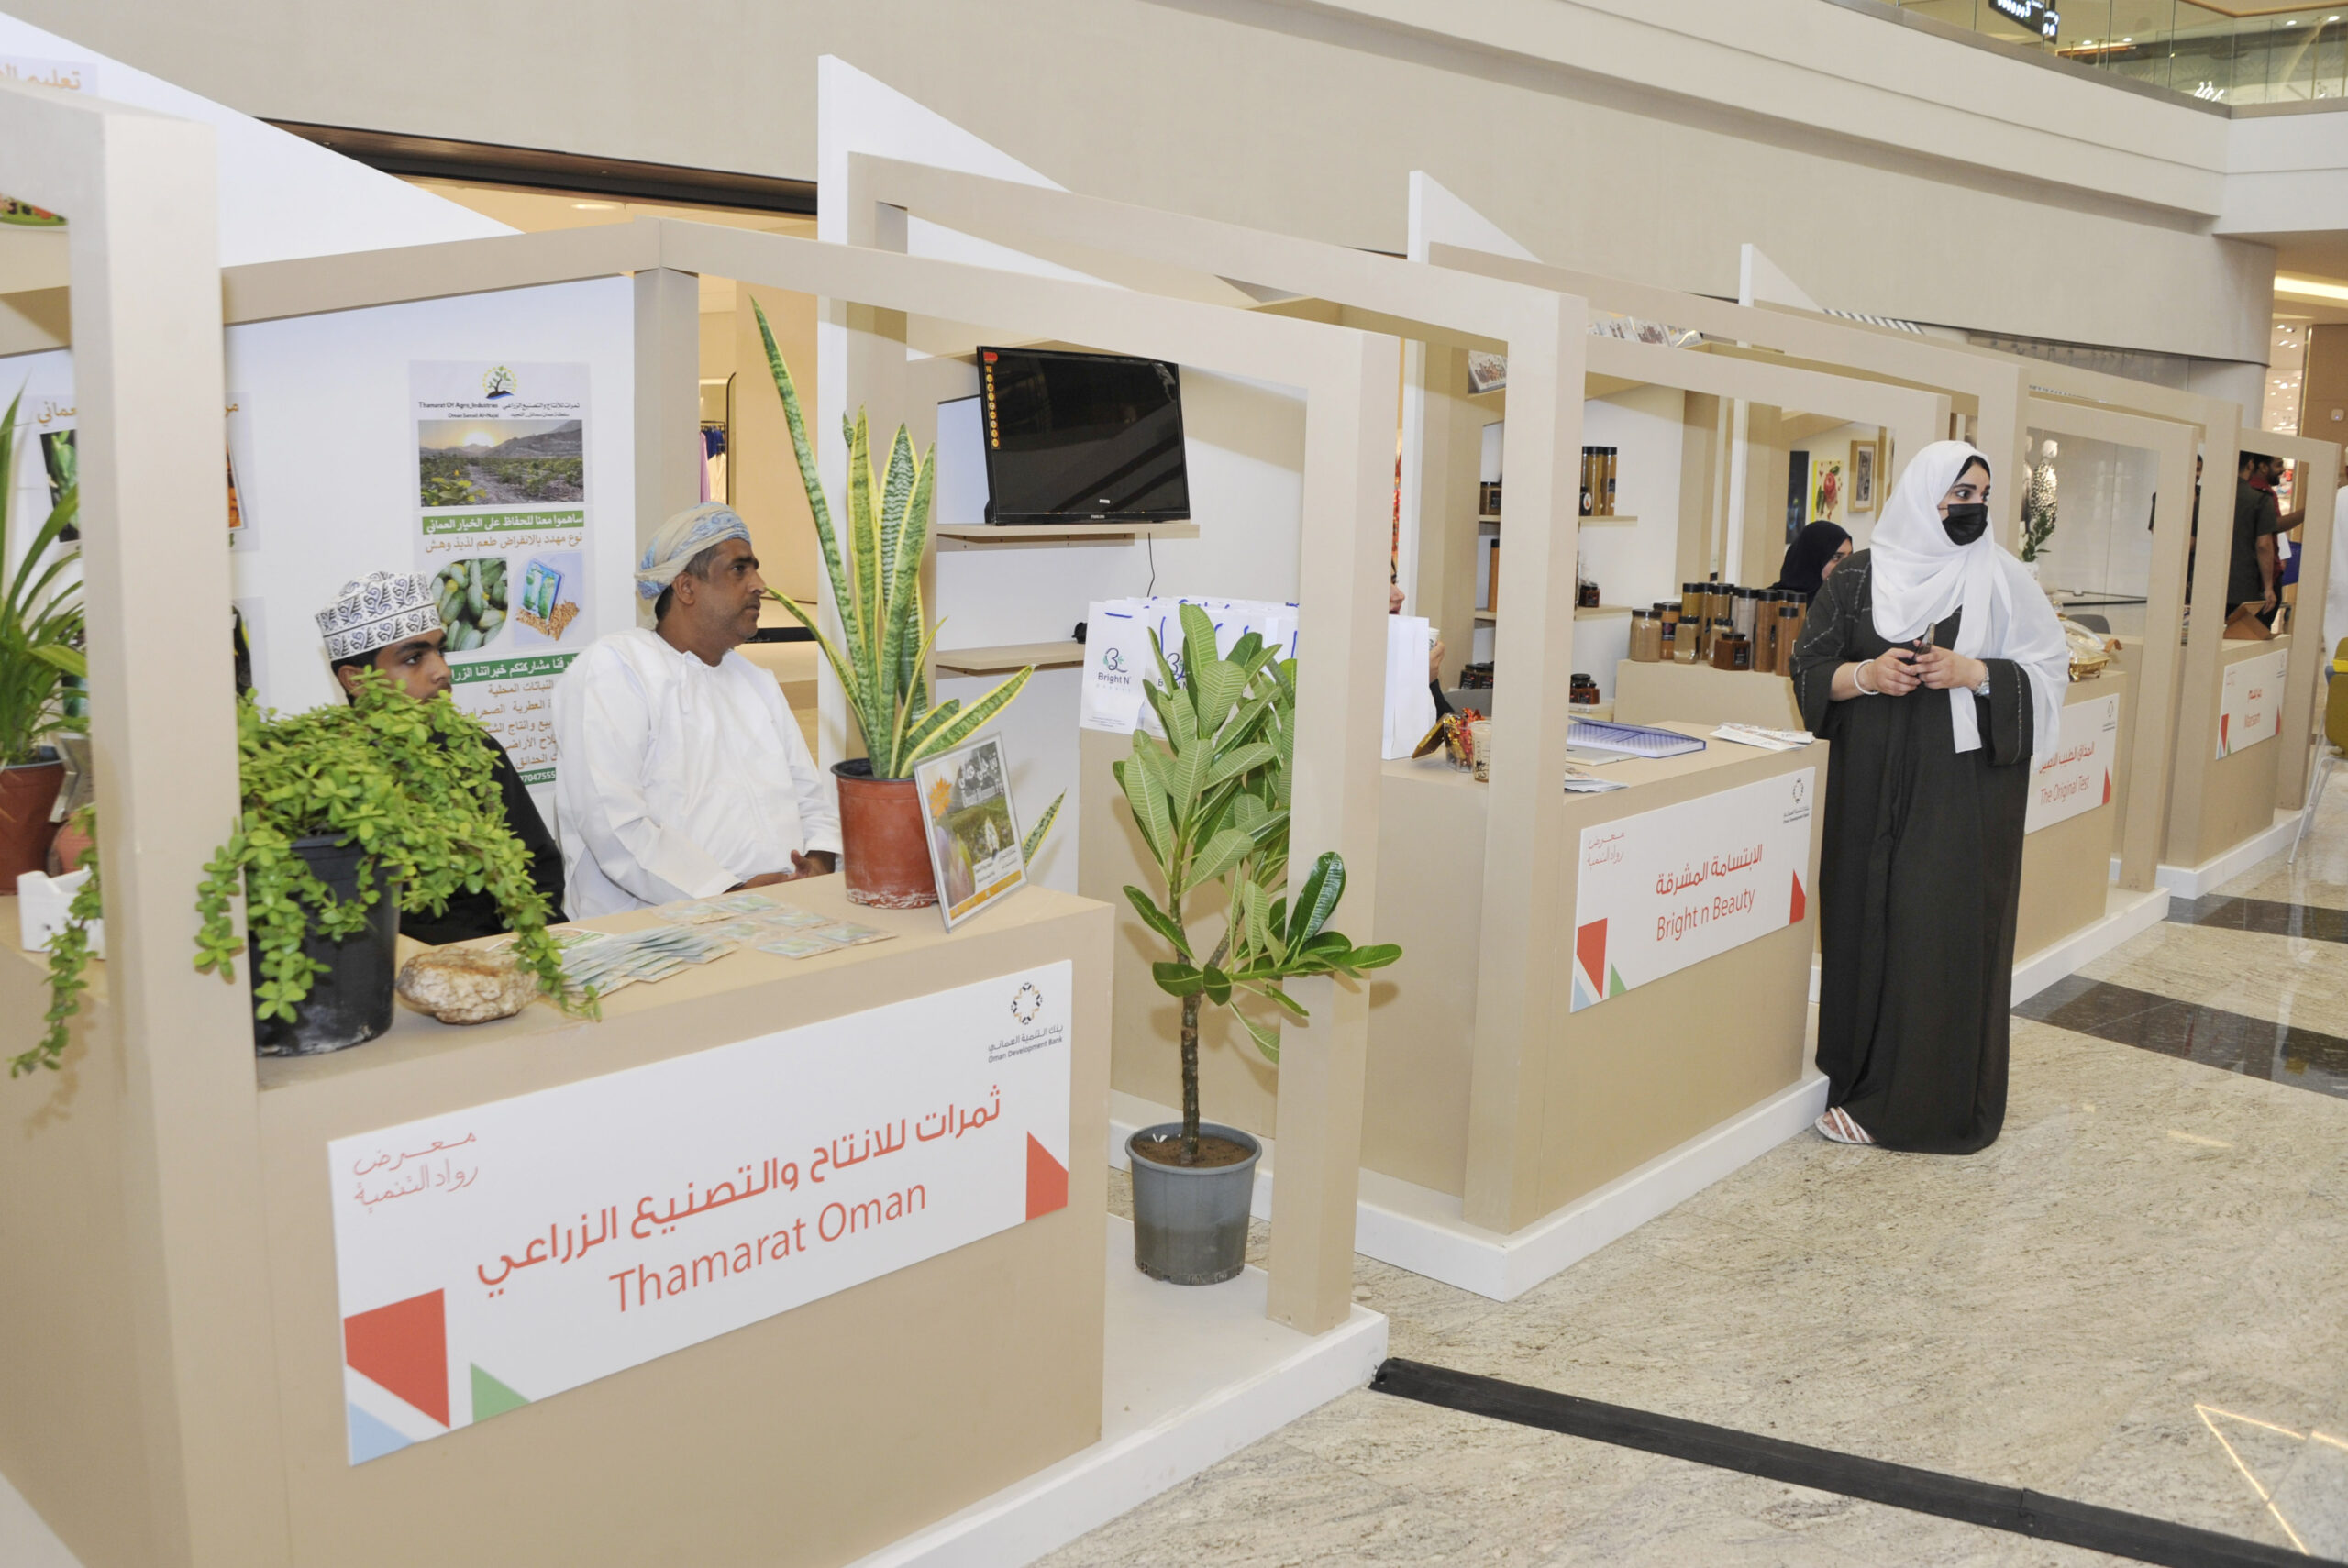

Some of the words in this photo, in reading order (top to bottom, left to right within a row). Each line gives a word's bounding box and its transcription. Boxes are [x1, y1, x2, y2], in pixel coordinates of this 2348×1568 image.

[426, 518, 456, 534] العماني
[457, 517, 483, 532] الخيار
[484, 518, 501, 530] على
[504, 515, 534, 526] للحفاظ
[535, 515, 552, 525] معنا
[553, 513, 583, 527] ساهموا
[426, 538, 452, 554] وهش
[454, 536, 474, 549] لذيذ
[476, 536, 498, 550] طعم
[500, 534, 542, 549] بالانقراض
[544, 535, 566, 546] مهدد
[569, 532, 583, 547] نوع
[451, 667, 473, 681] الزرا
[509, 660, 550, 679] مشاركتكم
[1097, 672, 1123, 685] Bright
[488, 683, 520, 698] المحلية
[2040, 788, 2053, 806] The
[1711, 843, 1763, 878] الابتسامة
[1656, 861, 1709, 896] المشرقة
[1656, 905, 1699, 942] Bright
[1700, 906, 1710, 924] n
[1712, 888, 1755, 921] Beauty
[1021, 1027, 1048, 1043] التنمية
[1048, 1024, 1064, 1035] بنك
[988, 1035, 1021, 1055] العماني
[988, 1053, 1007, 1064] Oman
[1007, 1041, 1047, 1057] Development
[1048, 1035, 1063, 1046] Bank
[914, 1084, 1002, 1143] ثمرات
[353, 1132, 478, 1176] معرض
[809, 1119, 908, 1183] للانتاج
[435, 1157, 479, 1194] رواد
[354, 1163, 431, 1215] التنمية
[629, 1157, 801, 1241] والتصنيع
[476, 1205, 618, 1300] الزراعي
[608, 1216, 808, 1313] Thamarat
[817, 1183, 927, 1243] Oman
